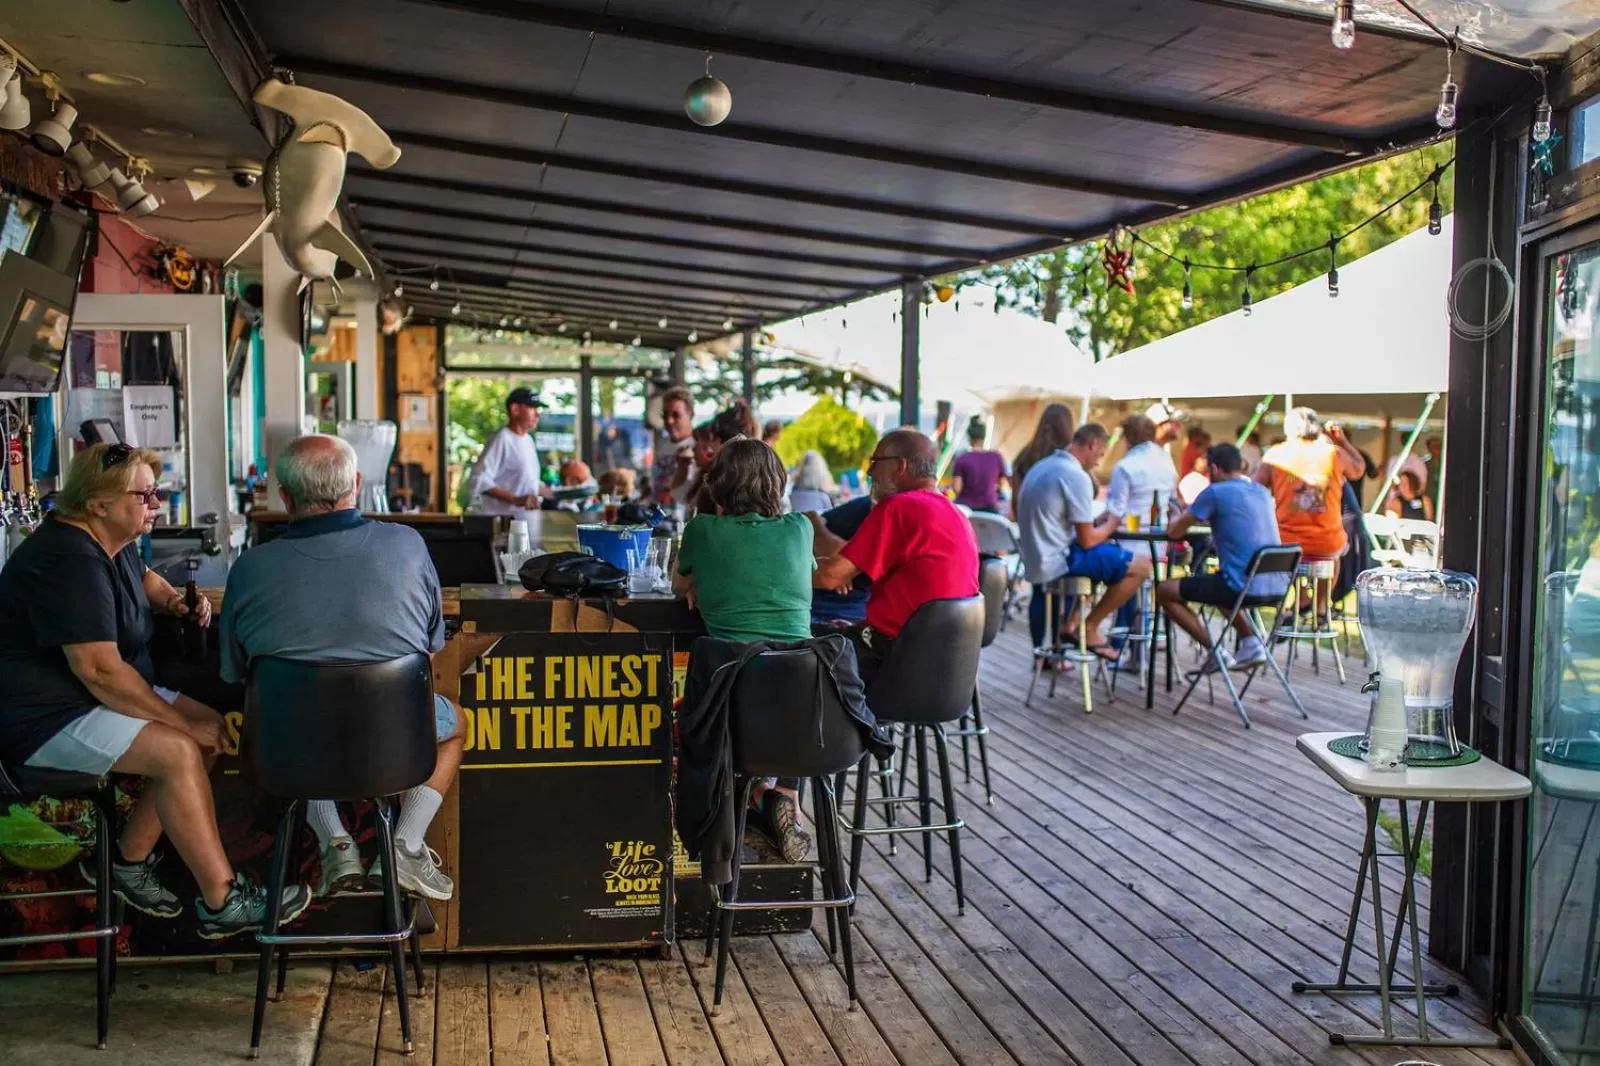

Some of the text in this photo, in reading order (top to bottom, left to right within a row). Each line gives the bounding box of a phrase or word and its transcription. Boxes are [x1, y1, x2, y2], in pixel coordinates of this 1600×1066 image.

[545, 654, 662, 699] FINEST
[510, 705, 574, 750] THE
[584, 704, 662, 748] MAP
[612, 840, 656, 862] Life
[602, 856, 664, 878] Love
[605, 878, 662, 893] LOOT
